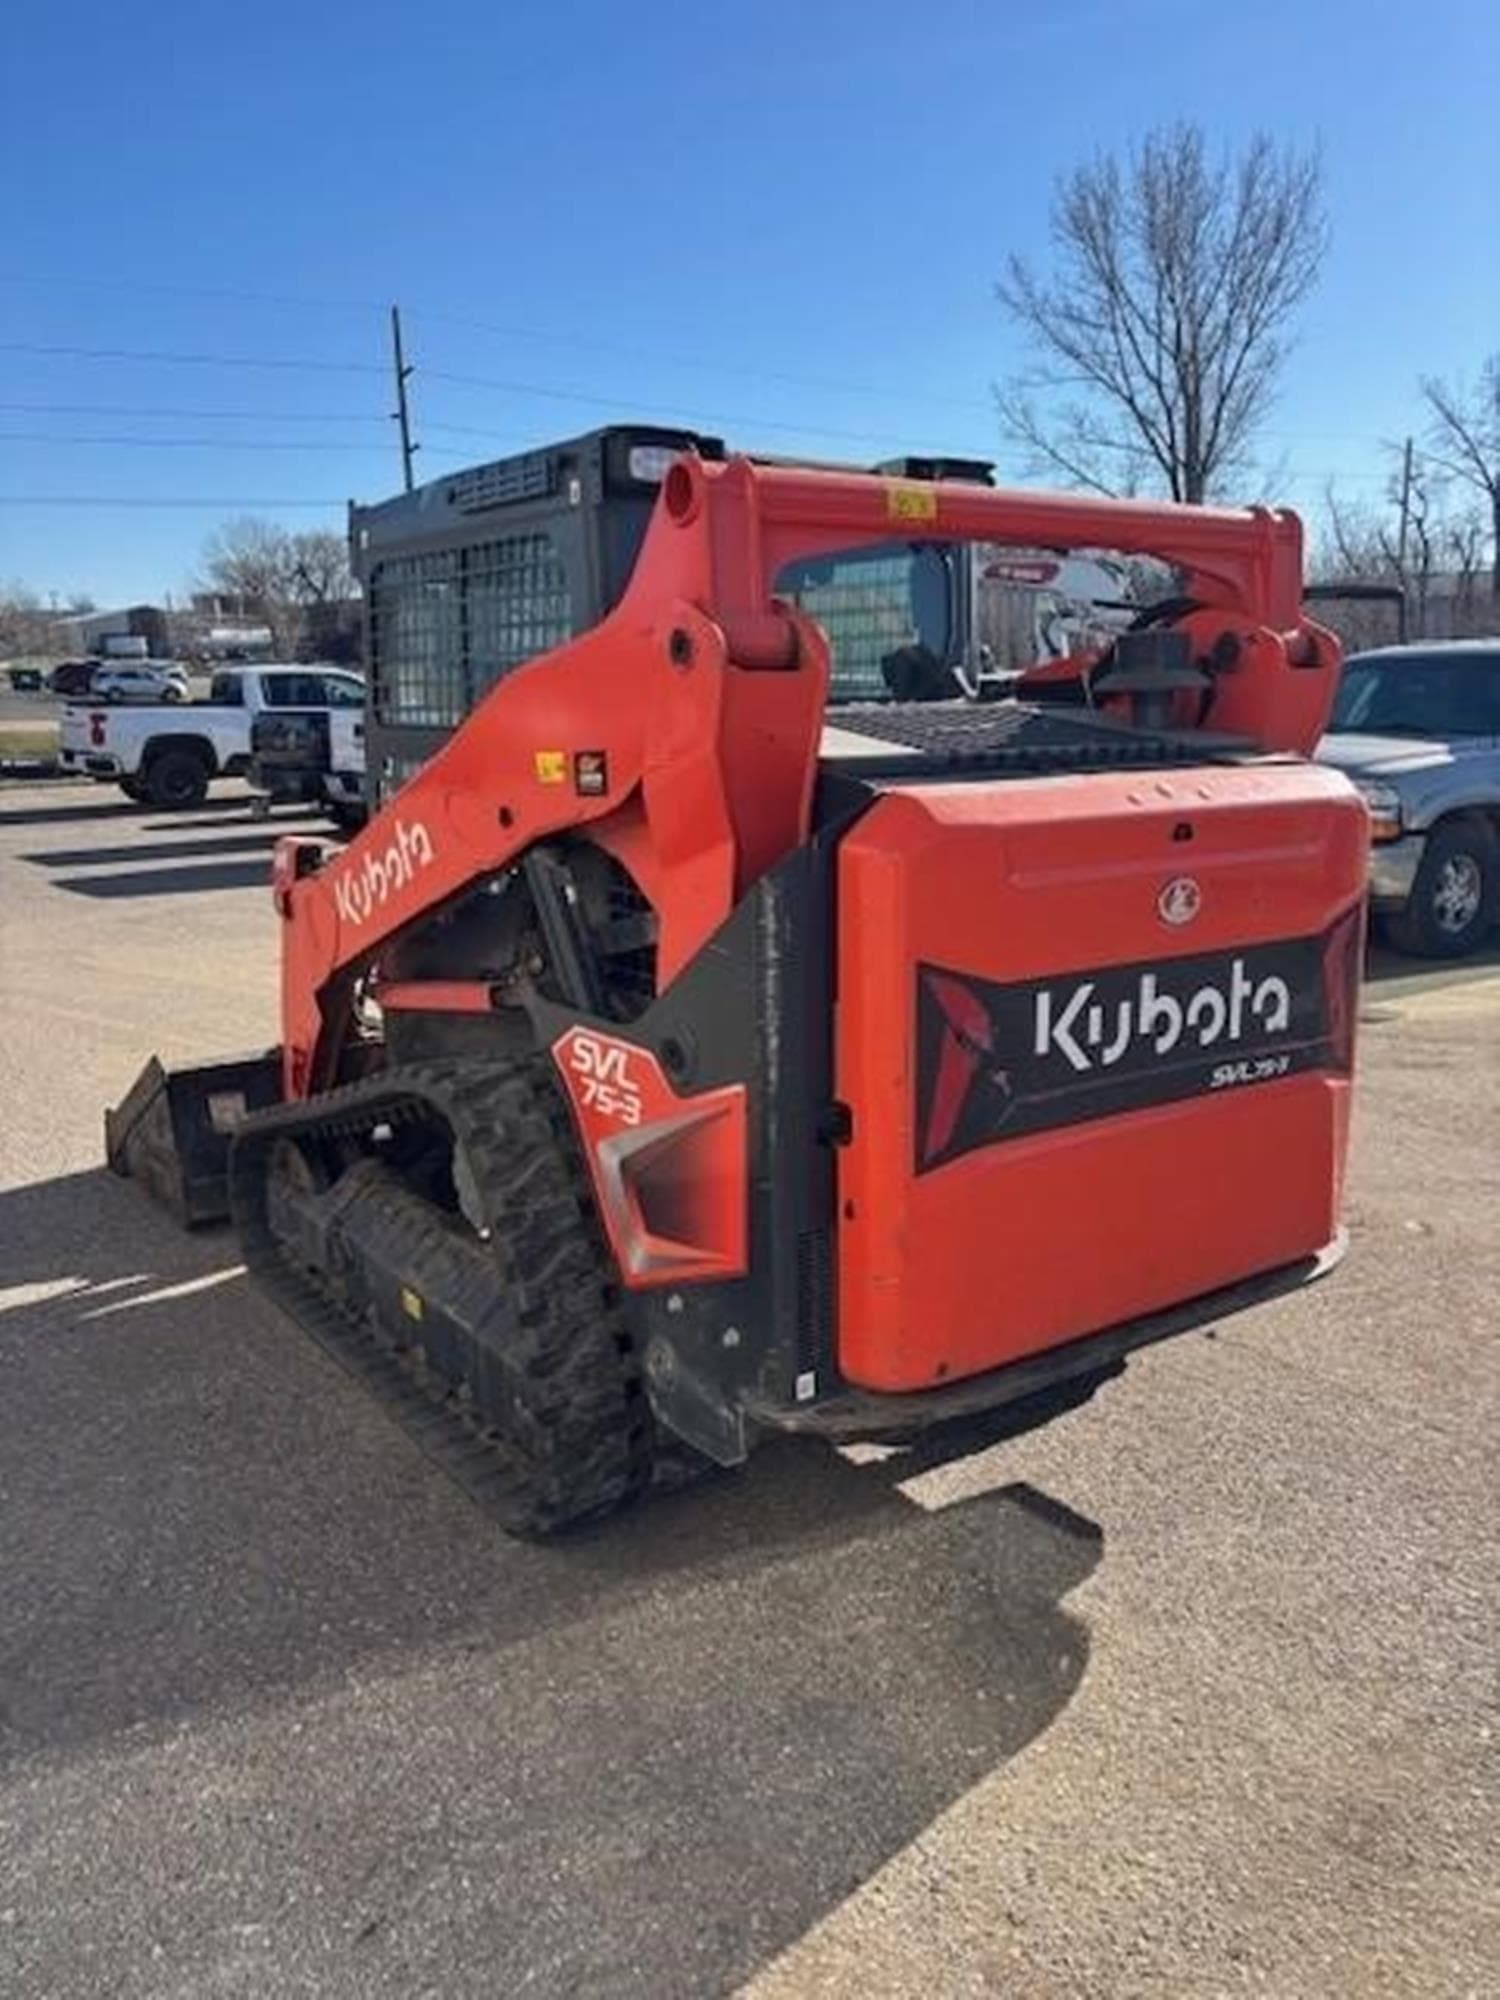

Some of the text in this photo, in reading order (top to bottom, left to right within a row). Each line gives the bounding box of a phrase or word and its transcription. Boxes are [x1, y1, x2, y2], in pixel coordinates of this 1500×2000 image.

[335, 821, 433, 924] Kubota
[1035, 959, 1290, 1071] Kubota
[570, 1036, 639, 1092] SVL
[579, 1076, 641, 1125] 75-3
